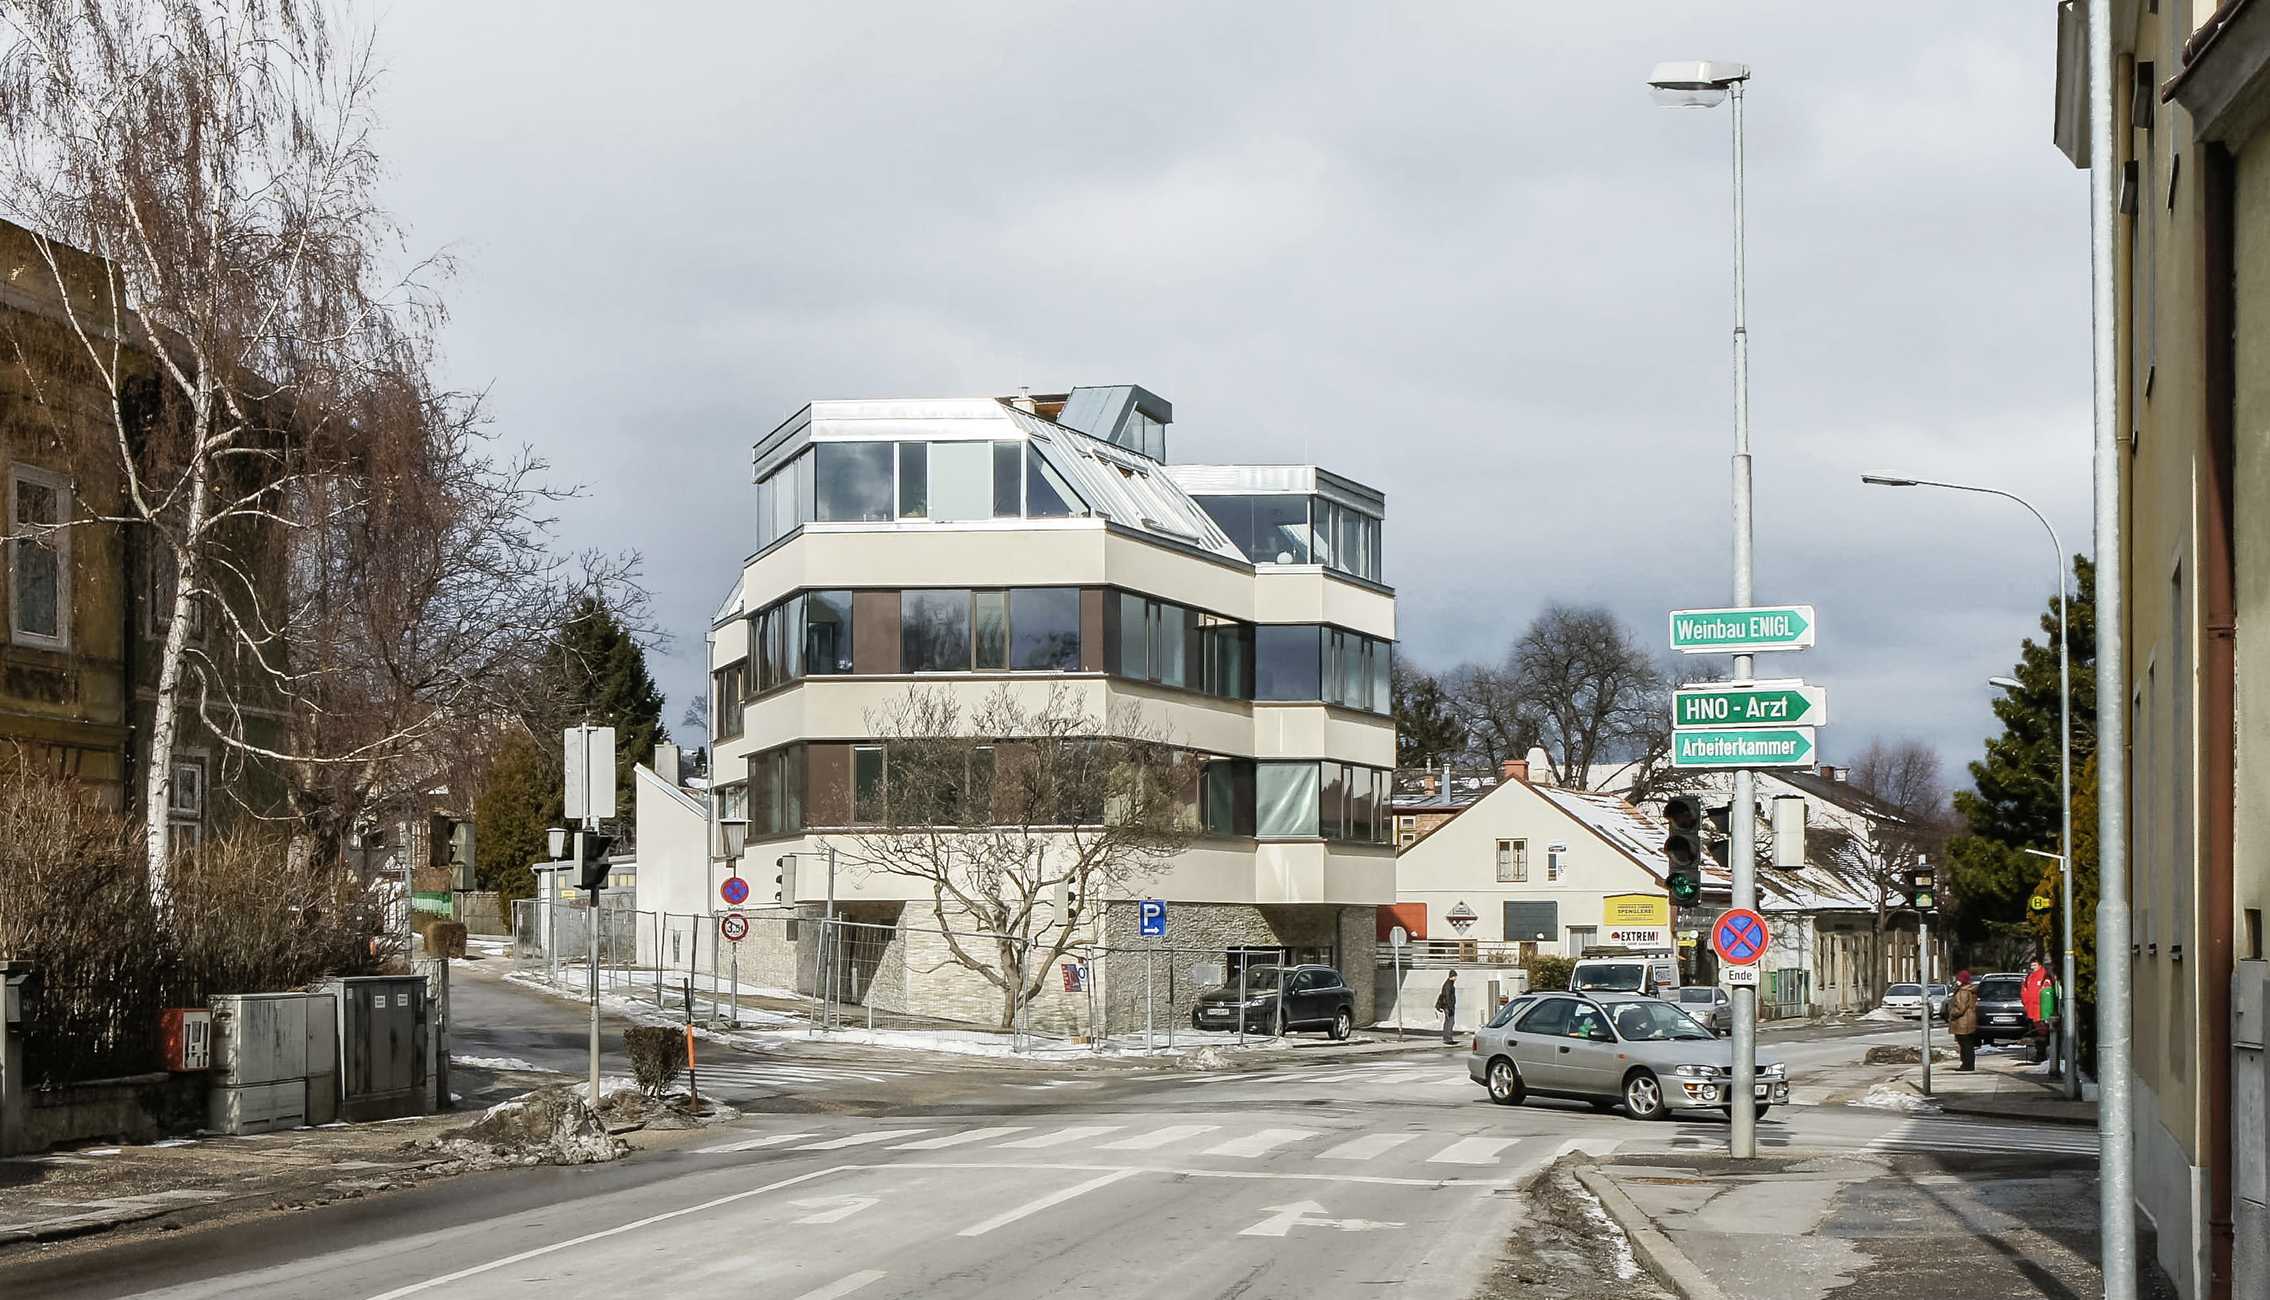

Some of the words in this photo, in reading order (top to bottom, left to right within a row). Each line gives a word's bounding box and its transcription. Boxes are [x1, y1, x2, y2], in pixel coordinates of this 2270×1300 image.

[1677, 618, 1746, 640] Weinbau
[1750, 616, 1793, 637] ENIGL
[1686, 697, 1728, 720] HNO
[1745, 696, 1788, 719] Arzt
[1682, 737, 1796, 757] Arbeiterkammer
[1143, 903, 1160, 927] P
[1728, 970, 1753, 981] Ende
